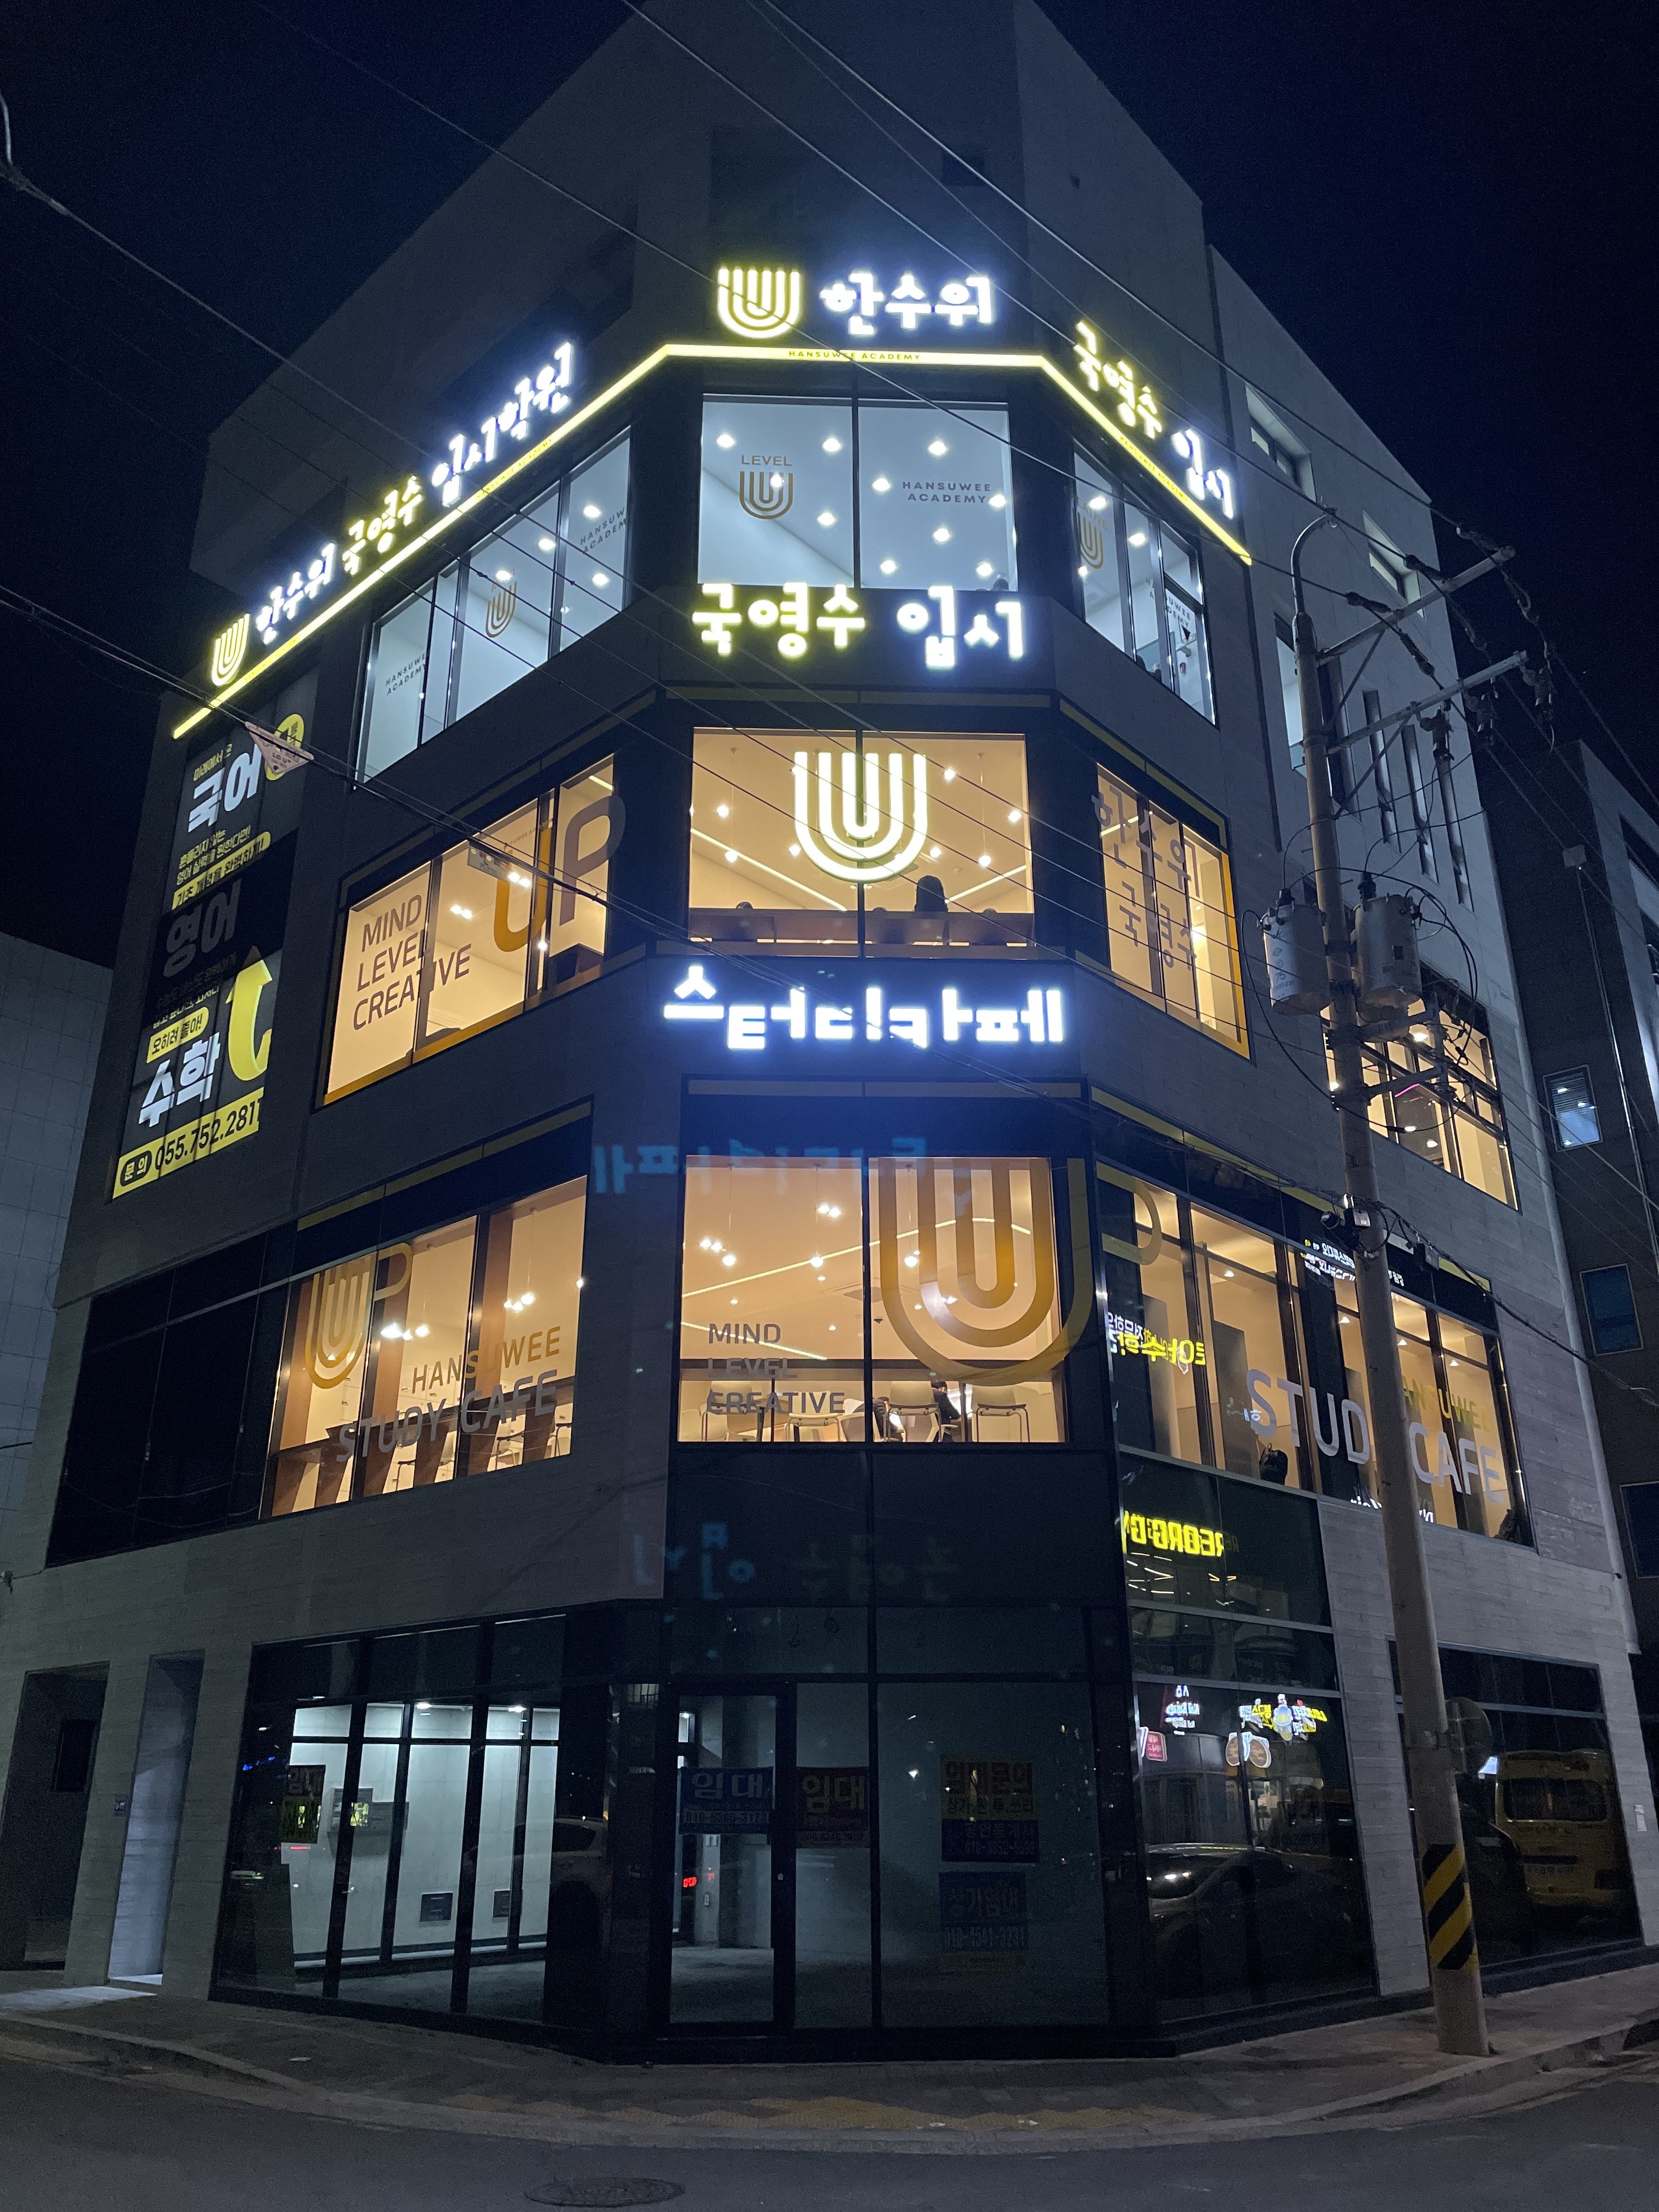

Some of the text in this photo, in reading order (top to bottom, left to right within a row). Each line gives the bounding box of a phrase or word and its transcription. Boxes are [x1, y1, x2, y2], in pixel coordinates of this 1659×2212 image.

[820, 272, 994, 336] 한수위
[789, 351, 855, 359] HANSUWE
[1073, 320, 1234, 520] 국영수 입시
[741, 455, 792, 466] LEVEL
[255, 341, 574, 645] 한수위 국영수 입시학원
[902, 481, 992, 492] HANSUWEE
[907, 494, 986, 504] ACADEMY
[580, 507, 625, 545] HANSUW
[583, 518, 628, 554] ACADEM
[692, 582, 1024, 668] 국영수 입시
[386, 652, 426, 686] HANSUWE
[272, 752, 281, 760] LG
[188, 743, 263, 833] 국어
[163, 879, 242, 977] 영어
[361, 894, 422, 952] MIND
[357, 929, 430, 992] LEVEL
[353, 943, 472, 1031] CREATIVE
[663, 964, 1064, 1050] 스터디카페
[151, 1029, 180, 1056] 오히려
[138, 1031, 221, 1128] 수학
[124, 1154, 149, 1182] 문의
[708, 1322, 781, 1345] MIND
[411, 1325, 561, 1395] HANSWEE
[706, 1357, 798, 1379] LEVEL
[460, 1368, 558, 1434] CAFE
[705, 1391, 846, 1415] CREATIVE
[336, 1397, 448, 1463] STUDY
[1246, 1368, 1503, 1503] STUD CAFE
[691, 1771, 764, 1801] 임대
[802, 1774, 866, 1814] 임대
